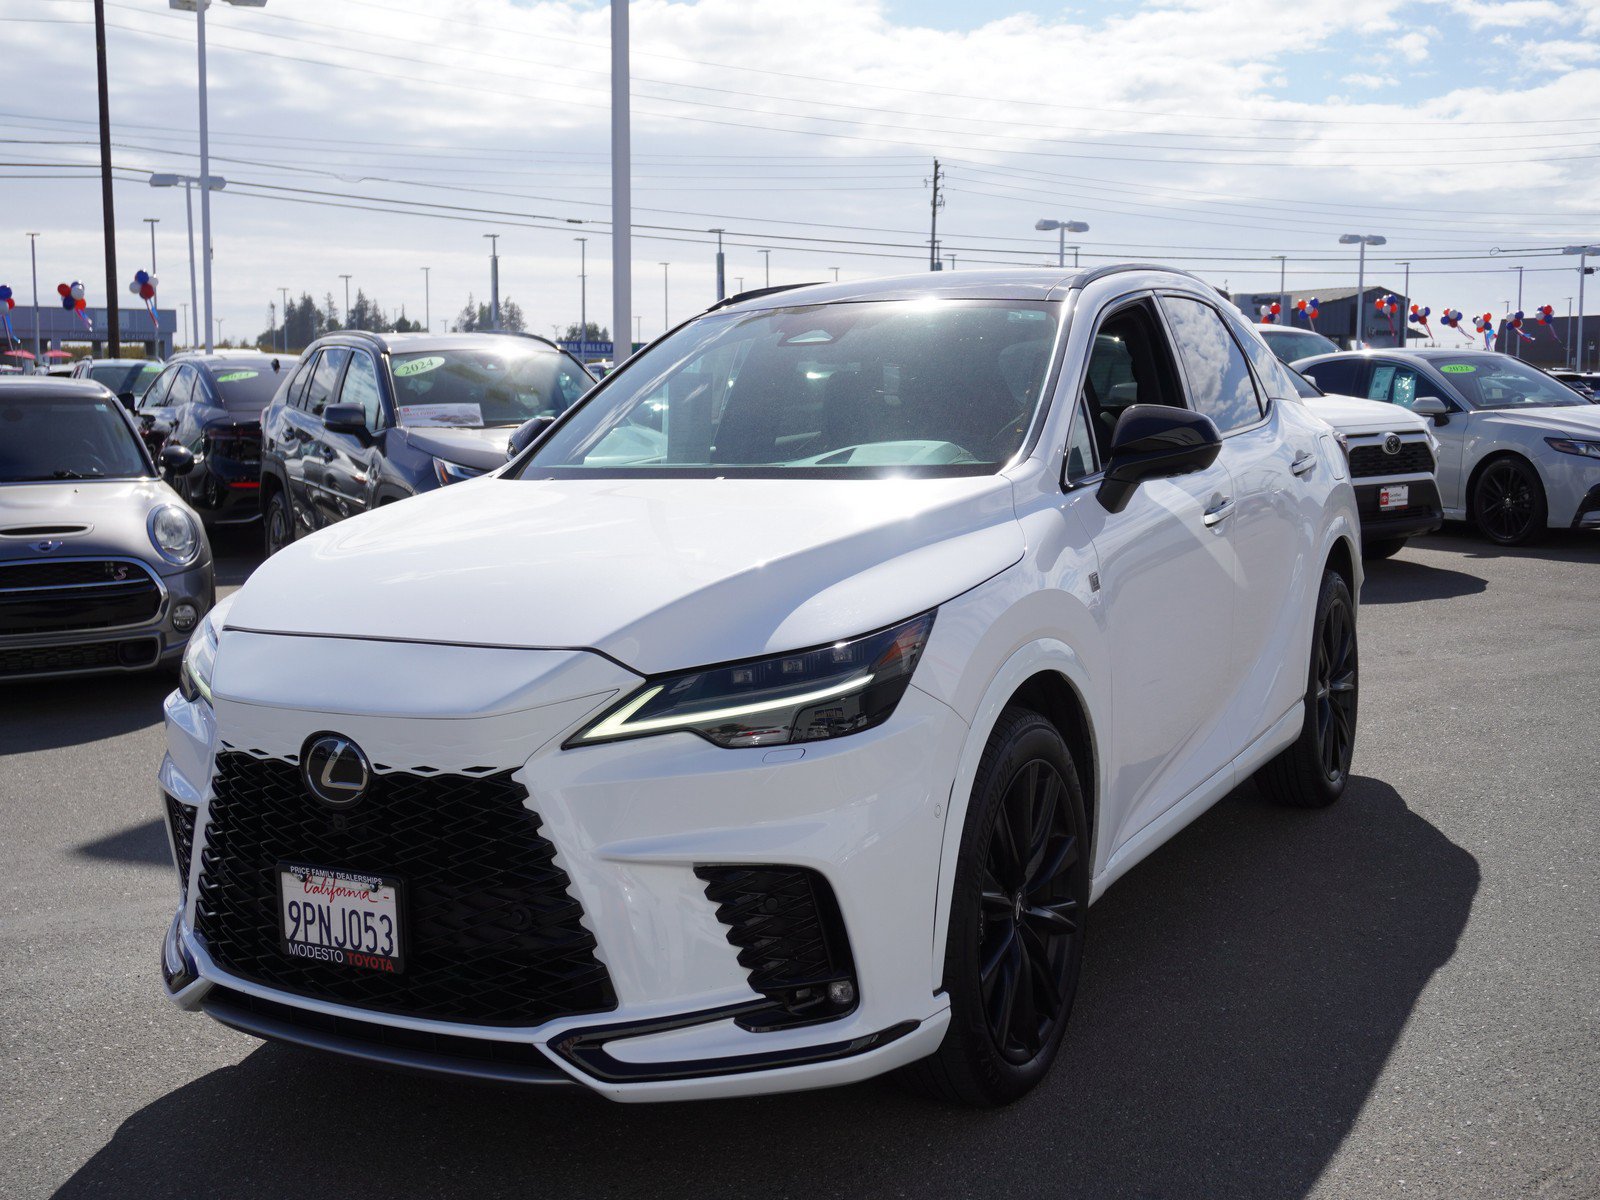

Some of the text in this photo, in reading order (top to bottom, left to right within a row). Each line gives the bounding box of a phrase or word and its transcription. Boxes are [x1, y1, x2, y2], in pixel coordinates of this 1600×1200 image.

[403, 357, 434, 375] 2024
[1449, 365, 1470, 373] 2022
[290, 866, 383, 885] PRICE FAMILY DEALERSHIPS
[304, 874, 378, 903] California
[288, 900, 394, 956] 9PNJ053
[288, 943, 394, 972] MODESTO TOYOTA
